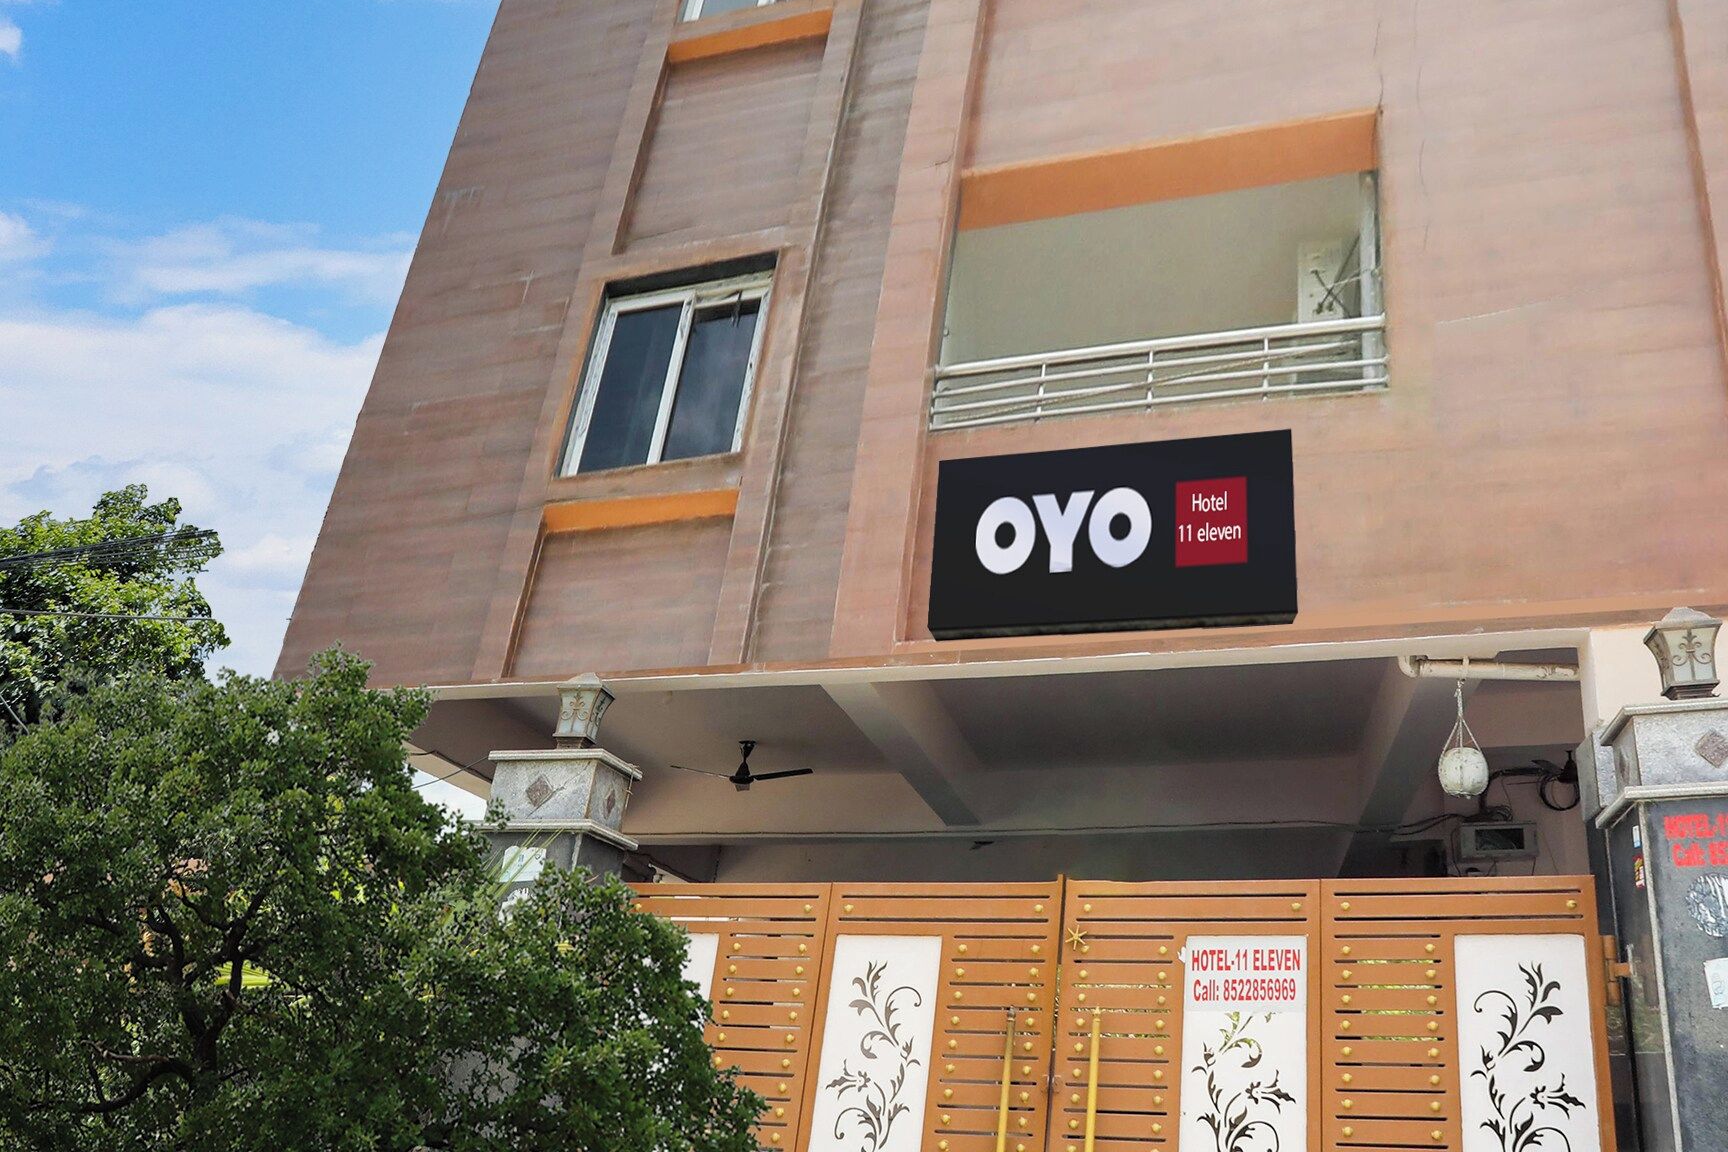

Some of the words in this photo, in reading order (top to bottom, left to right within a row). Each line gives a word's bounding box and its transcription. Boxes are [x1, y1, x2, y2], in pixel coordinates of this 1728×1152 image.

[1192, 490, 1228, 512] Hotel
[975, 486, 1152, 575] OYO
[1178, 524, 1192, 542] 11
[1197, 522, 1241, 542] eleven
[1191, 949, 1248, 971] HOTEL-11
[1253, 949, 1301, 971] ELEVEN
[1193, 979, 1219, 1001] Call:
[1223, 978, 1296, 1001] 8522856969
